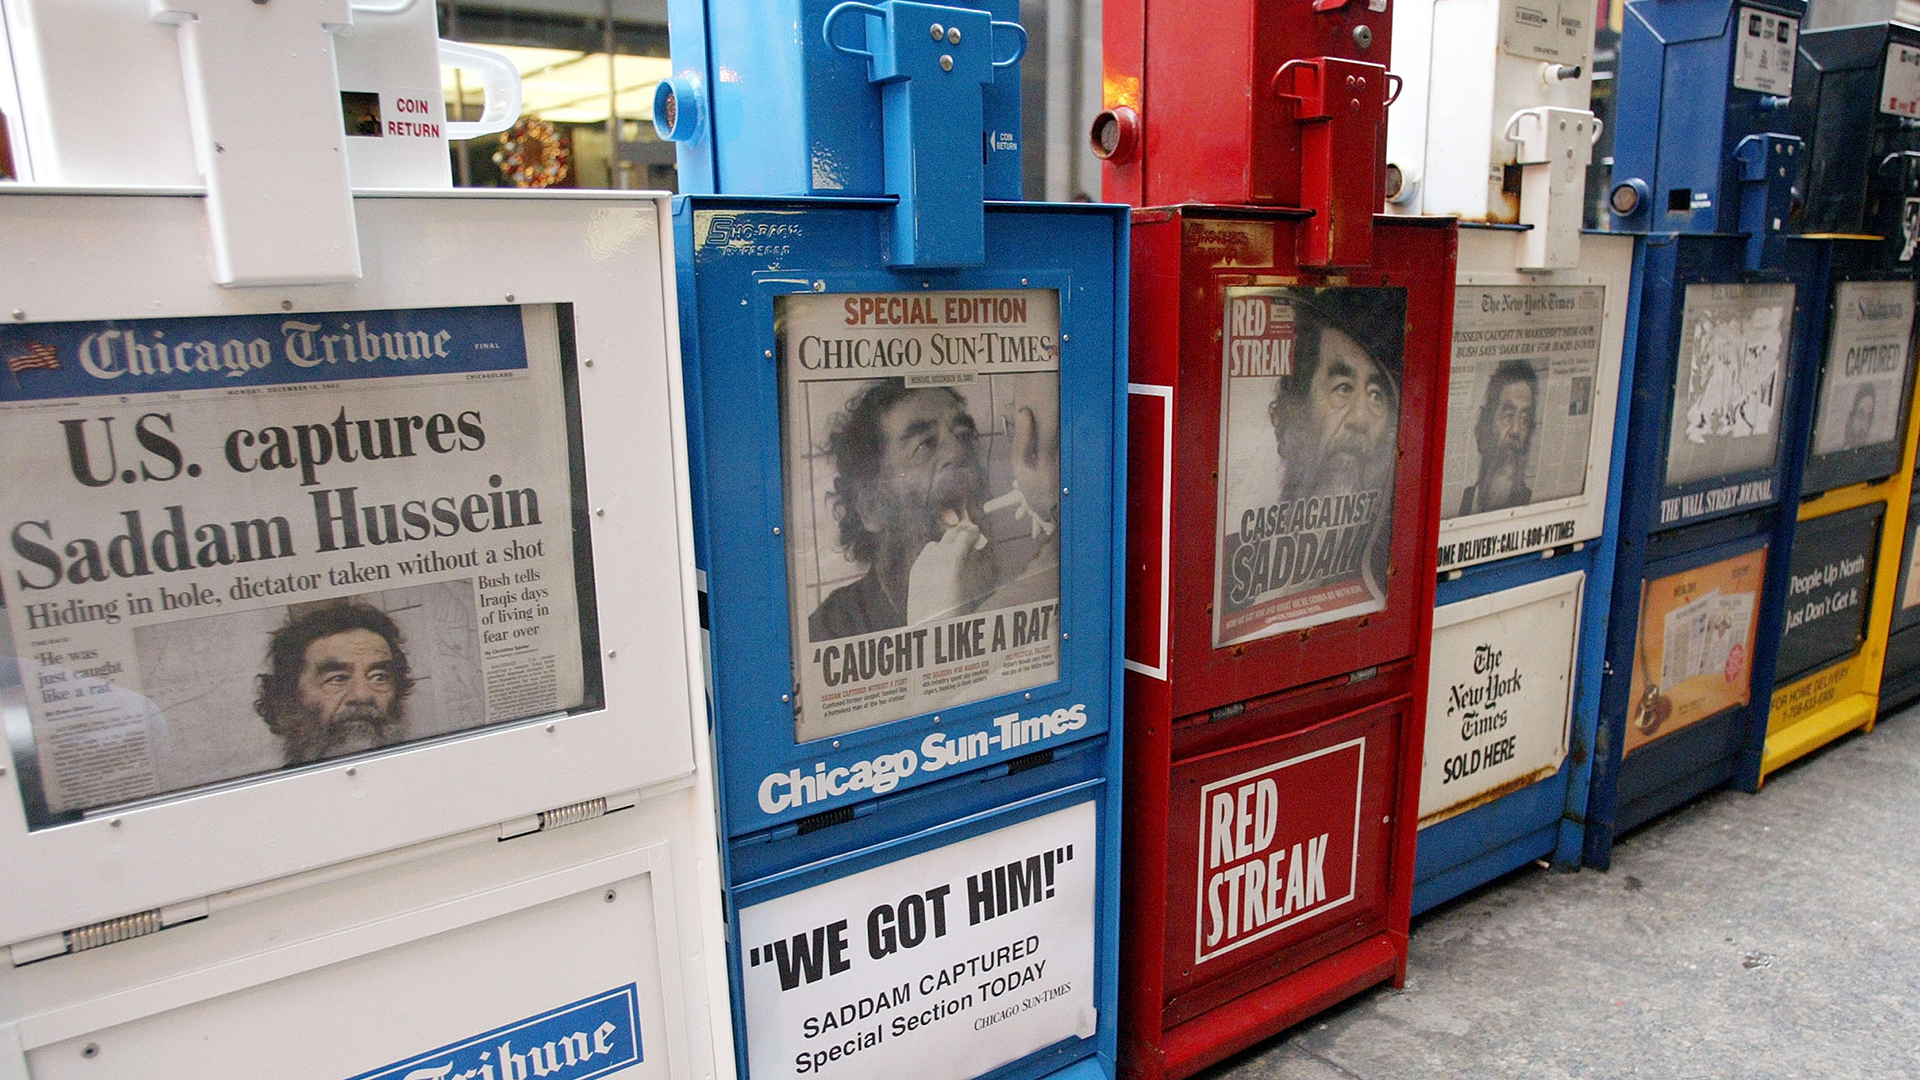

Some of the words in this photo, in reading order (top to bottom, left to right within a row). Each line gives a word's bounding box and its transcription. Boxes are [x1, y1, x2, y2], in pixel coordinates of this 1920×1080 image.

[396, 98, 429, 114] COIN
[388, 120, 440, 138] RETURN
[843, 297, 938, 325] SPECIAL
[944, 297, 1027, 324] EDITION
[1231, 299, 1267, 337] RED
[1481, 294, 1499, 313] The
[1502, 294, 1524, 312] New
[1524, 292, 1548, 315] York
[1548, 292, 1576, 313] Times
[79, 327, 272, 379] Chicago
[281, 320, 452, 368] Tribune
[474, 342, 500, 350] FINAL
[798, 334, 922, 371] CHICAGO
[929, 333, 1051, 366] SUN-TIMES
[1230, 339, 1292, 377] STREAK
[1456, 346, 1478, 358] BUSH
[1478, 345, 1497, 357] SAYS
[1845, 343, 1900, 377] CAPTURED
[465, 371, 514, 381] CHICAGOLAND
[59, 412, 202, 488] U.S.
[224, 406, 486, 486] captures
[1240, 502, 1290, 544] CASE
[1290, 490, 1379, 533] AGAINST
[1660, 499, 1680, 524] THE
[1681, 492, 1704, 518] WALL
[1705, 485, 1739, 513] STREET
[1737, 478, 1772, 507] JOURNAL
[10, 505, 296, 592] Saddam
[308, 474, 543, 554] Hussein
[1437, 541, 1456, 567] OME
[1520, 520, 1575, 549] 1-800-NYTIMES
[478, 573, 510, 590] Bush
[515, 568, 541, 584] tells
[1231, 522, 1371, 604] SADDAM
[1790, 567, 1822, 596] People
[1823, 563, 1838, 587] Up
[1839, 554, 1865, 579] North
[26, 593, 119, 632] Hiding
[127, 592, 155, 616] in
[159, 582, 222, 613] hole,
[229, 569, 322, 602] dictator
[329, 560, 391, 588] taken
[397, 550, 479, 577] without
[486, 548, 498, 565] a
[503, 538, 545, 562] shot
[480, 591, 518, 608] Iraqis
[521, 587, 549, 602] days
[481, 611, 495, 625] of
[499, 606, 533, 623] living
[537, 604, 550, 617] in
[483, 630, 509, 644] fear
[513, 625, 540, 638] over
[1785, 605, 1803, 636] Just
[1805, 595, 1831, 624] Don't
[1831, 591, 1849, 612] Get
[68, 650, 98, 661] was
[813, 628, 928, 687] 'CAUGHT
[934, 617, 986, 665] LIKE
[991, 614, 1007, 653] A
[1012, 603, 1059, 648] RAT'
[1473, 642, 1503, 675] The
[38, 671, 68, 689] just
[73, 660, 123, 679] caught
[41, 687, 70, 703] like
[74, 687, 85, 697] a
[1446, 681, 1484, 718] New
[1484, 667, 1523, 710] York
[1771, 693, 1788, 711] FOR
[1790, 682, 1812, 700] HOME
[1813, 667, 1849, 691] DELIVERY
[1461, 708, 1508, 742] Times
[757, 749, 919, 815] Chicago
[920, 703, 1088, 772] Sun-Times
[1442, 748, 1481, 785] SOLD
[1483, 734, 1517, 770] HERE
[1210, 778, 1278, 870] RED
[1207, 833, 1329, 947] STREAK
[749, 918, 852, 992] "WE
[866, 883, 952, 961] GOT
[966, 844, 1074, 927] HIM!"
[802, 981, 911, 1039] SADDAM
[918, 935, 1040, 996] CAPTURED
[973, 1003, 1020, 1032] CHICAGO
[1022, 981, 1072, 1012] SUN-TIMES
[795, 1023, 883, 1075] Special
[891, 993, 974, 1038] Section
[977, 960, 1047, 1003] TODAY
